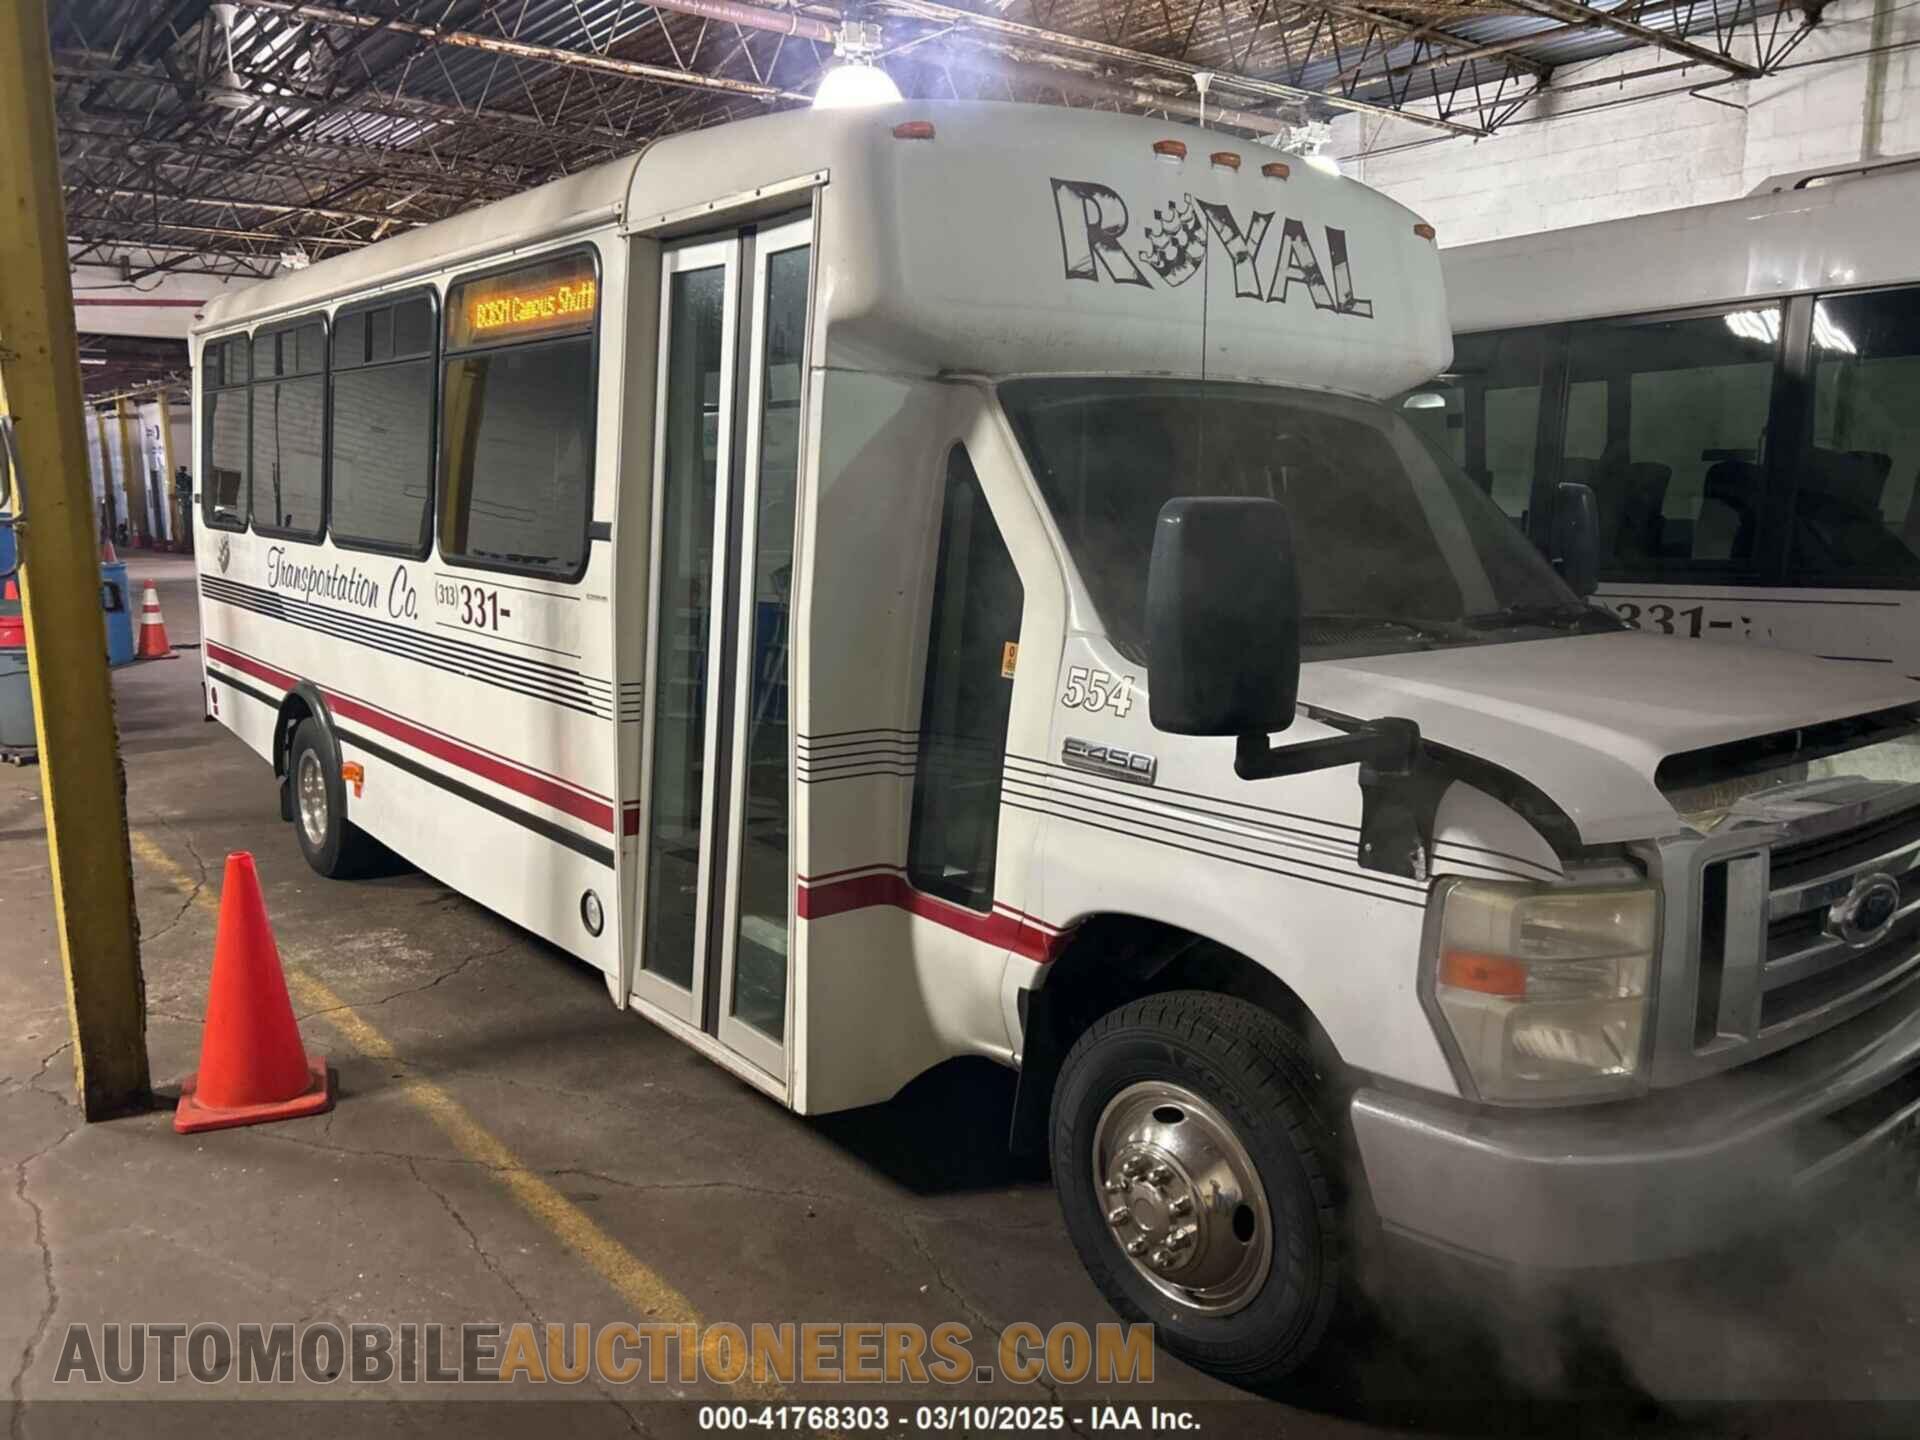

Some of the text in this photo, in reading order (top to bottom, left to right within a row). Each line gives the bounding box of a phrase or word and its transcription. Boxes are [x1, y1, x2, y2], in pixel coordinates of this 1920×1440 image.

[1050, 177, 1374, 319] ROYAL
[512, 296, 557, 321] Campus
[267, 546, 419, 620] Transportation Co.
[434, 580, 512, 631] (313) 331-
[1061, 665, 1136, 719] 554
